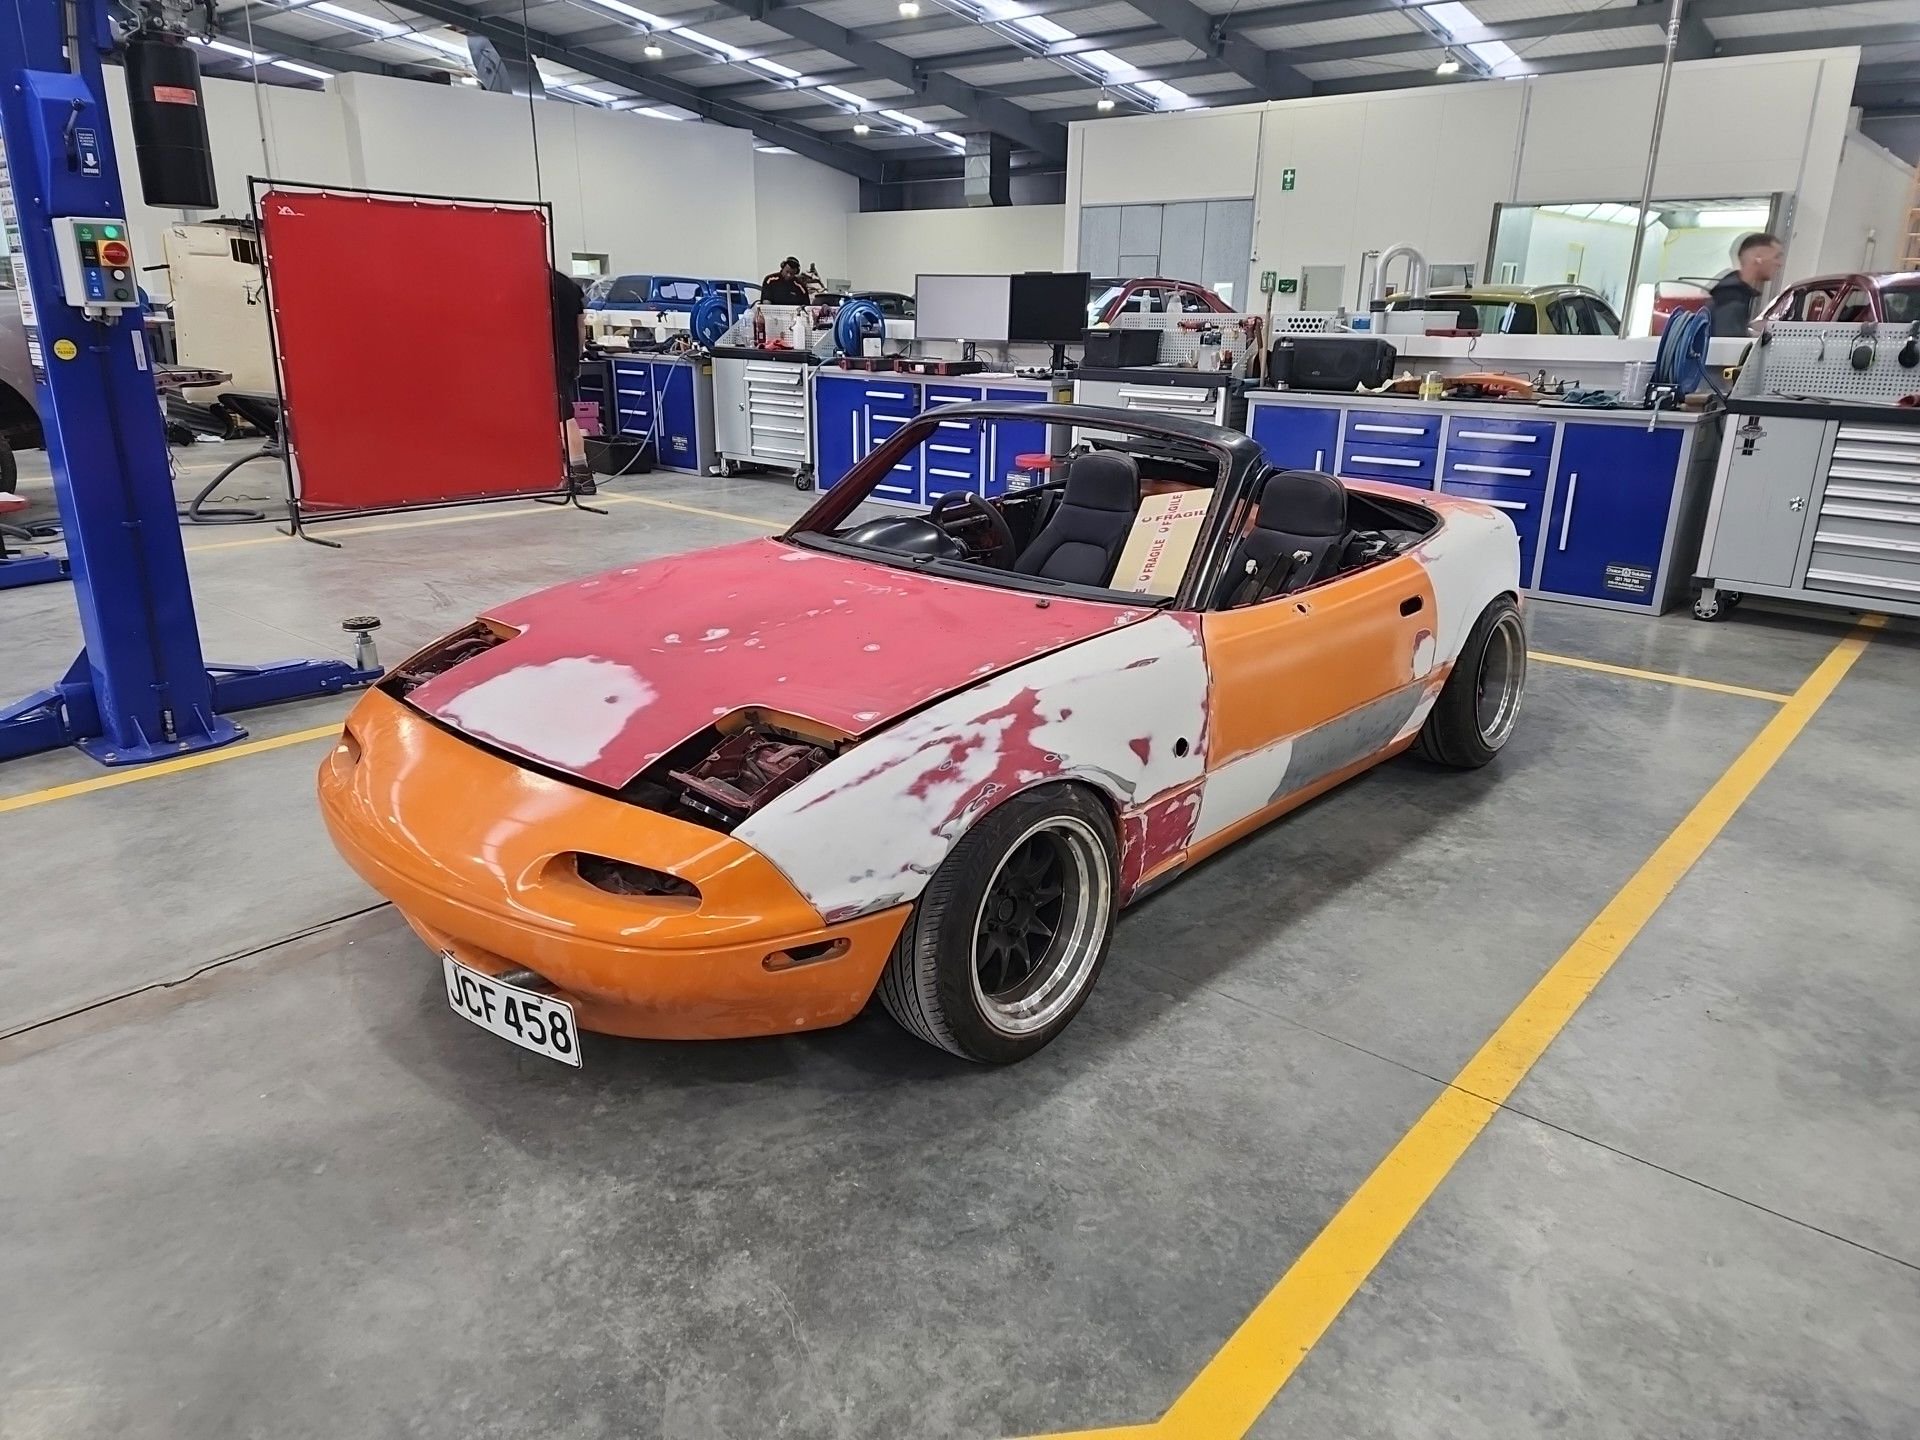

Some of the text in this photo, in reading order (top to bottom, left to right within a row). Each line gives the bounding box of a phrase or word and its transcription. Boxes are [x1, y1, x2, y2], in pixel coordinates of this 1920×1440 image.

[1143, 539, 1165, 573] FRAGILE
[450, 968, 572, 1054] JCF 458
